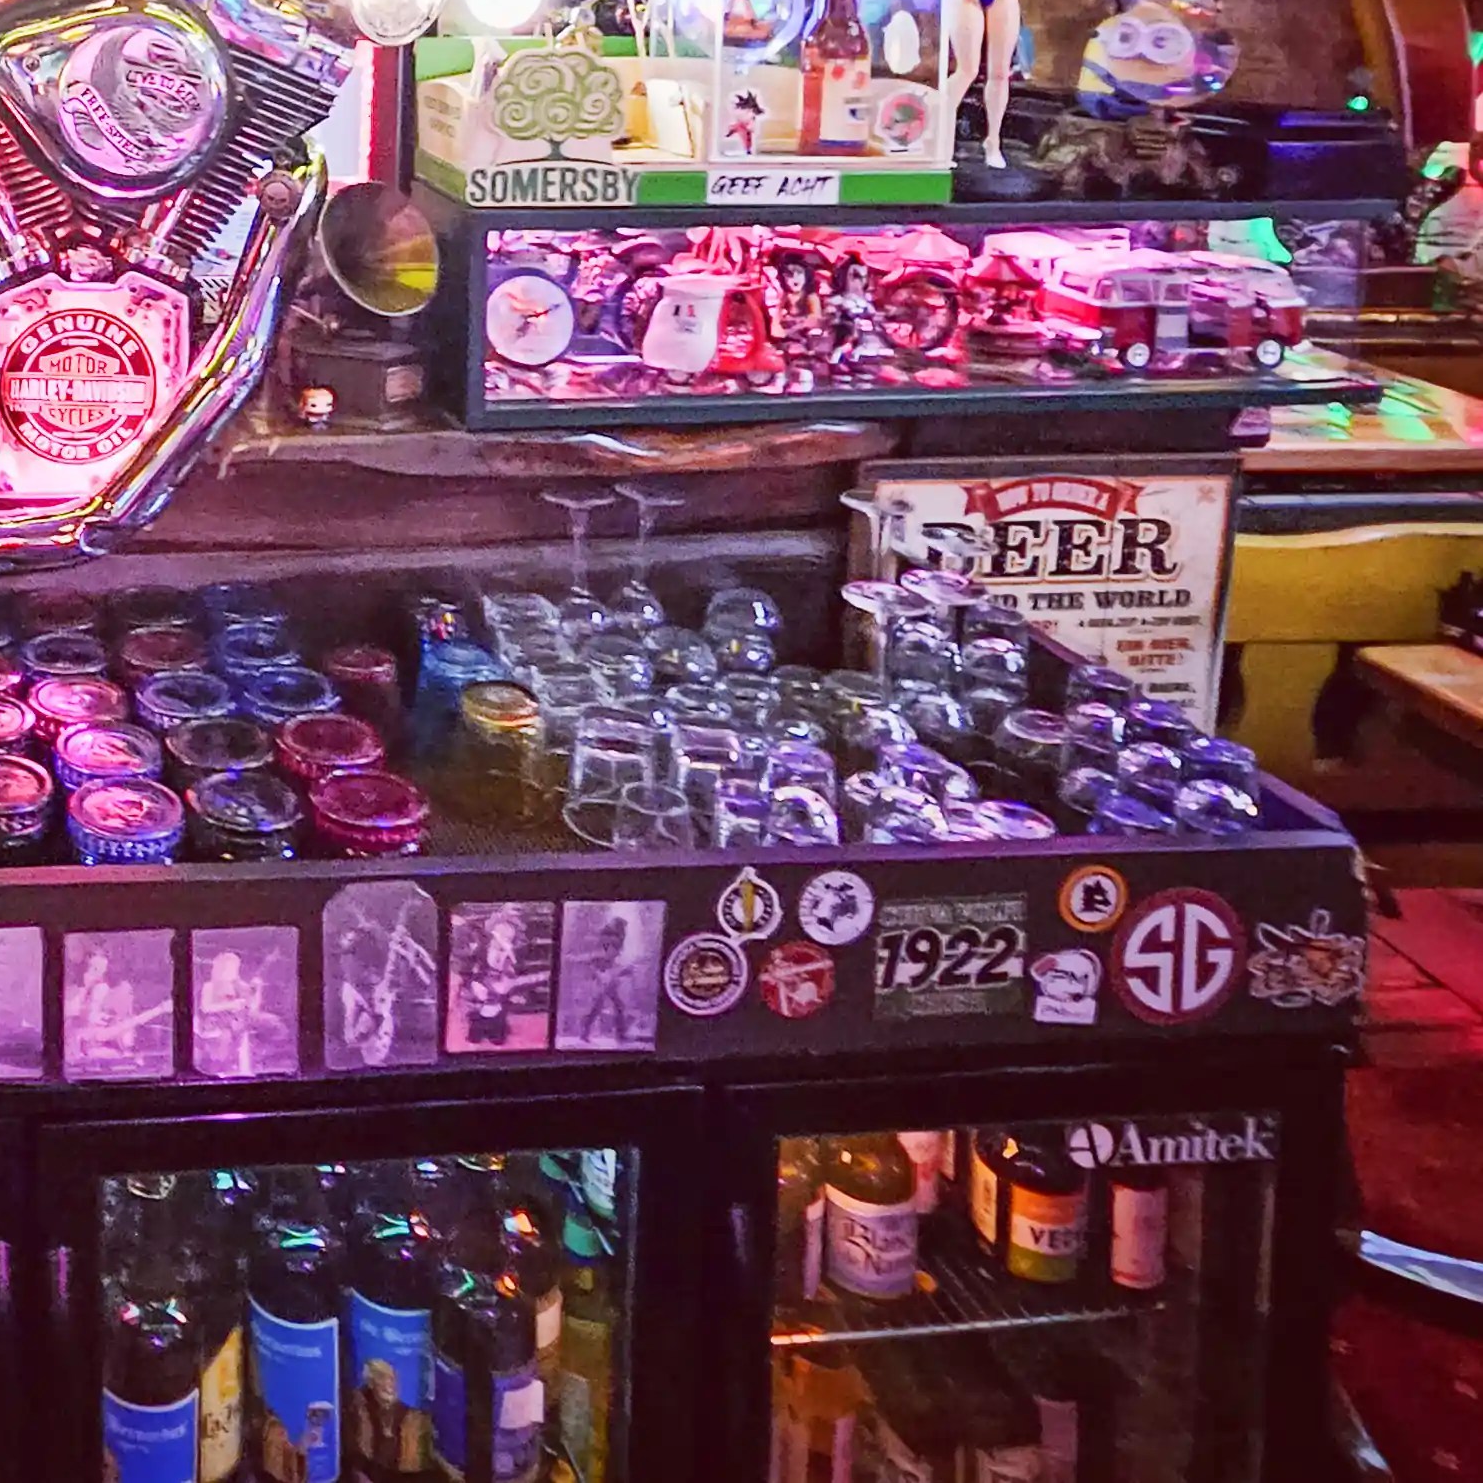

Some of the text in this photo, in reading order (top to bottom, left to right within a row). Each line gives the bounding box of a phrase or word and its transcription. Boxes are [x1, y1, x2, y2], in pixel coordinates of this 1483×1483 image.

[469, 168, 638, 204] SOMERSBY
[711, 174, 764, 196] GEEF
[19, 314, 141, 356] GENUINE
[49, 353, 108, 375] MOTOR
[48, 407, 106, 426] CYCLES
[18, 421, 135, 459] MOTOR OIL
[1028, 591, 1085, 611] THE
[1093, 589, 1193, 609] WORLD
[877, 923, 1021, 994] 1922
[1109, 1115, 1276, 1167] Amitek
